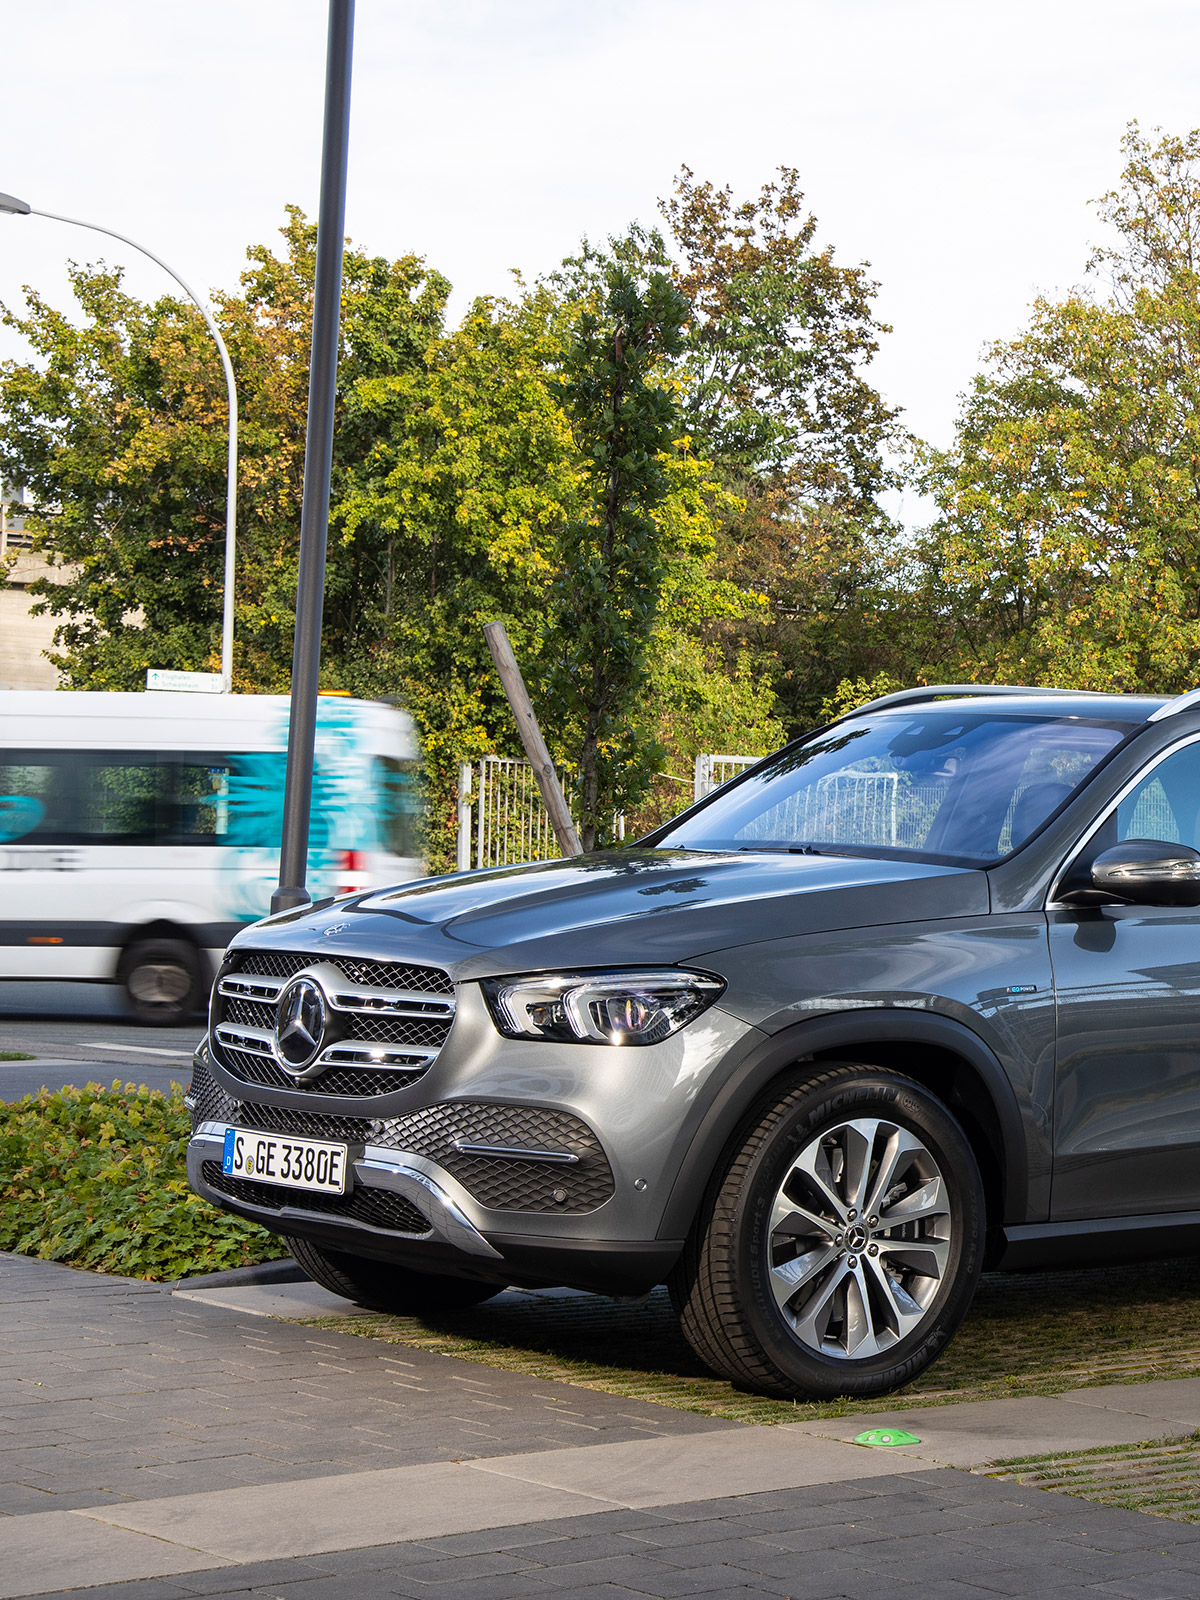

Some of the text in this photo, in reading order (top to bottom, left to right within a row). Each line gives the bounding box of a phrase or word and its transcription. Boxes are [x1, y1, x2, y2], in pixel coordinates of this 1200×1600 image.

[808, 1087, 900, 1126] MICHELIN
[226, 1155, 232, 1166] D
[234, 1136, 342, 1187] S GE 3380E
